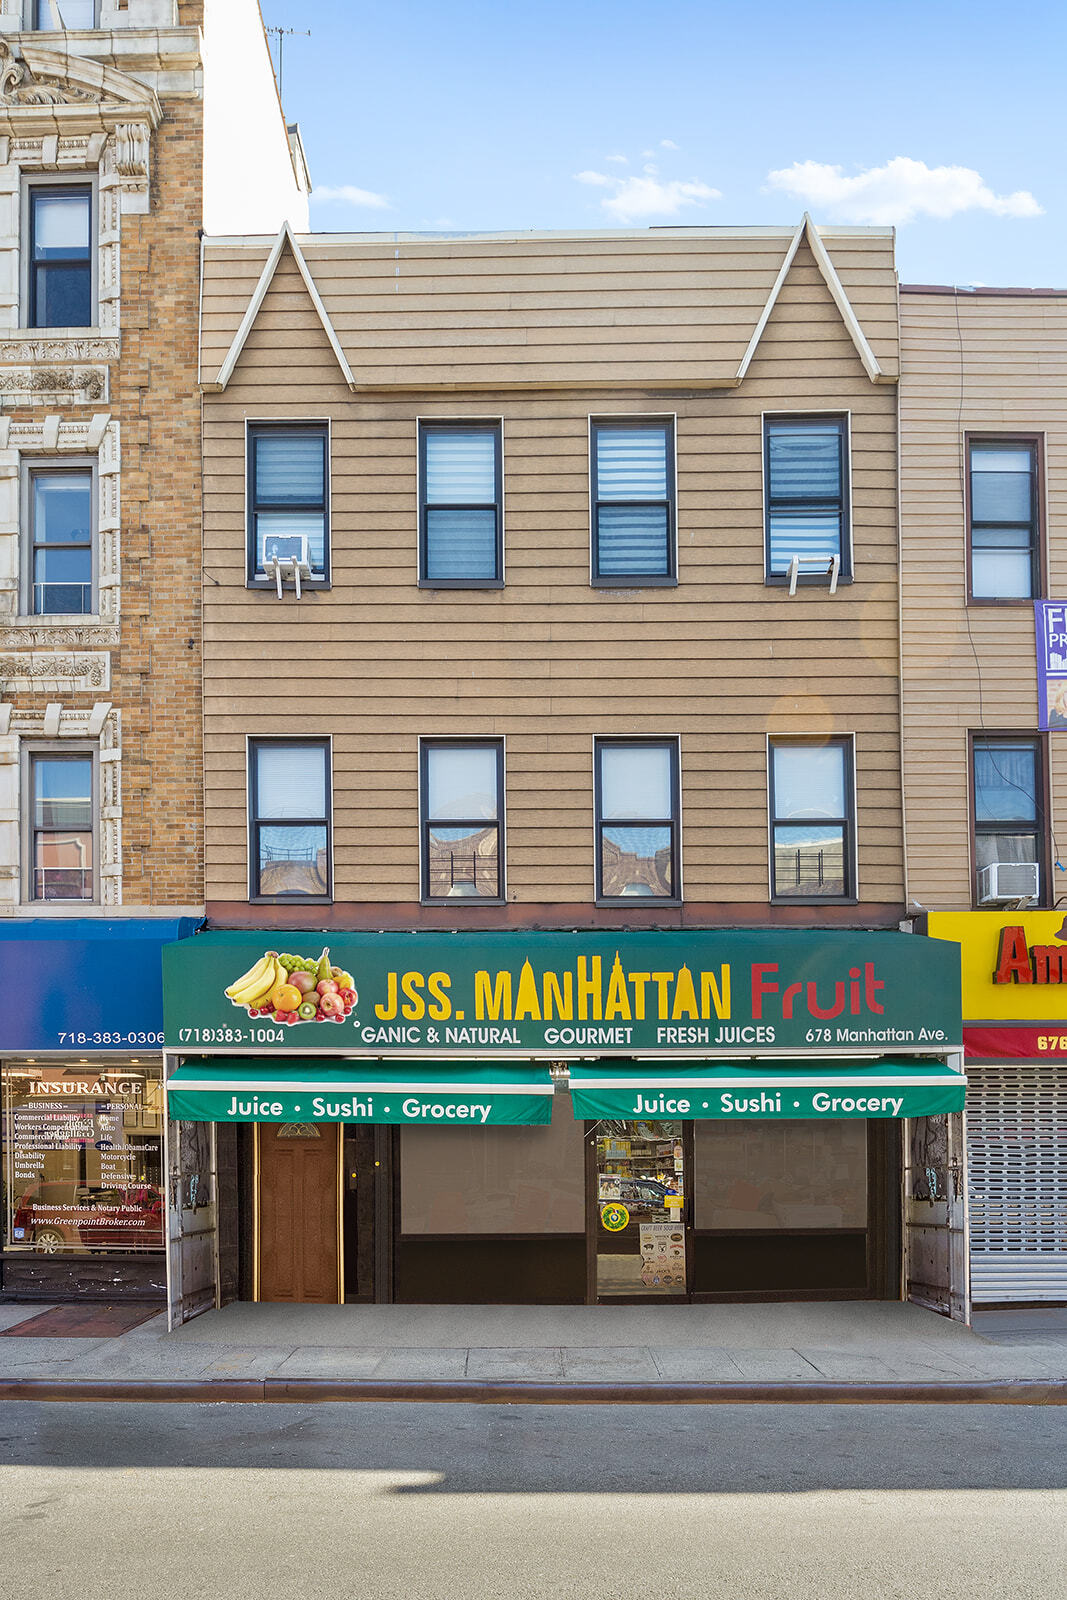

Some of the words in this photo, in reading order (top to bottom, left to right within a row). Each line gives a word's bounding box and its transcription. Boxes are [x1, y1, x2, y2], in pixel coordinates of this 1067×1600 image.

[375, 971, 465, 1021] JSS.
[475, 950, 731, 1021] MANHATTAN
[751, 962, 885, 1020] Fruit
[58, 1032, 165, 1044] 718-383-0306
[179, 1029, 284, 1043] (718)383-1004
[361, 1027, 421, 1043] GANIC
[426, 1027, 440, 1043] &
[445, 1027, 521, 1043] NATURAL
[544, 1027, 633, 1044] GOURMET
[657, 1026, 709, 1043] FRESH
[714, 1026, 776, 1043] JUICES
[805, 1028, 832, 1042] 678
[836, 1027, 914, 1042] Manhattan
[918, 1027, 948, 1041] Ave.
[1037, 1036, 1067, 1050] 676
[29, 1081, 142, 1094] INSURANCE
[227, 1097, 283, 1117] Juice
[312, 1098, 373, 1117] Sushi
[632, 1094, 690, 1114] Juice
[720, 1092, 781, 1113] Sushi
[812, 1092, 904, 1116] Grocery
[402, 1098, 491, 1123] Grocery
[14, 1113, 52, 1121] Commercial
[53, 1113, 80, 1122] Liability
[100, 1114, 119, 1122] Home
[14, 1123, 41, 1131] Workers
[100, 1124, 116, 1132] Auto
[14, 1142, 55, 1150] Professional
[55, 1142, 82, 1151] Liability
[14, 1152, 46, 1160] Disability
[100, 1153, 136, 1161] Motorcycle
[101, 1172, 134, 1180] Defensive
[101, 1182, 127, 1191] Driving
[127, 1182, 152, 1190] Course
[32, 1203, 62, 1211] Business
[98, 1204, 121, 1213] Notary
[30, 1216, 146, 1227] www.GreenpointBroker.com
